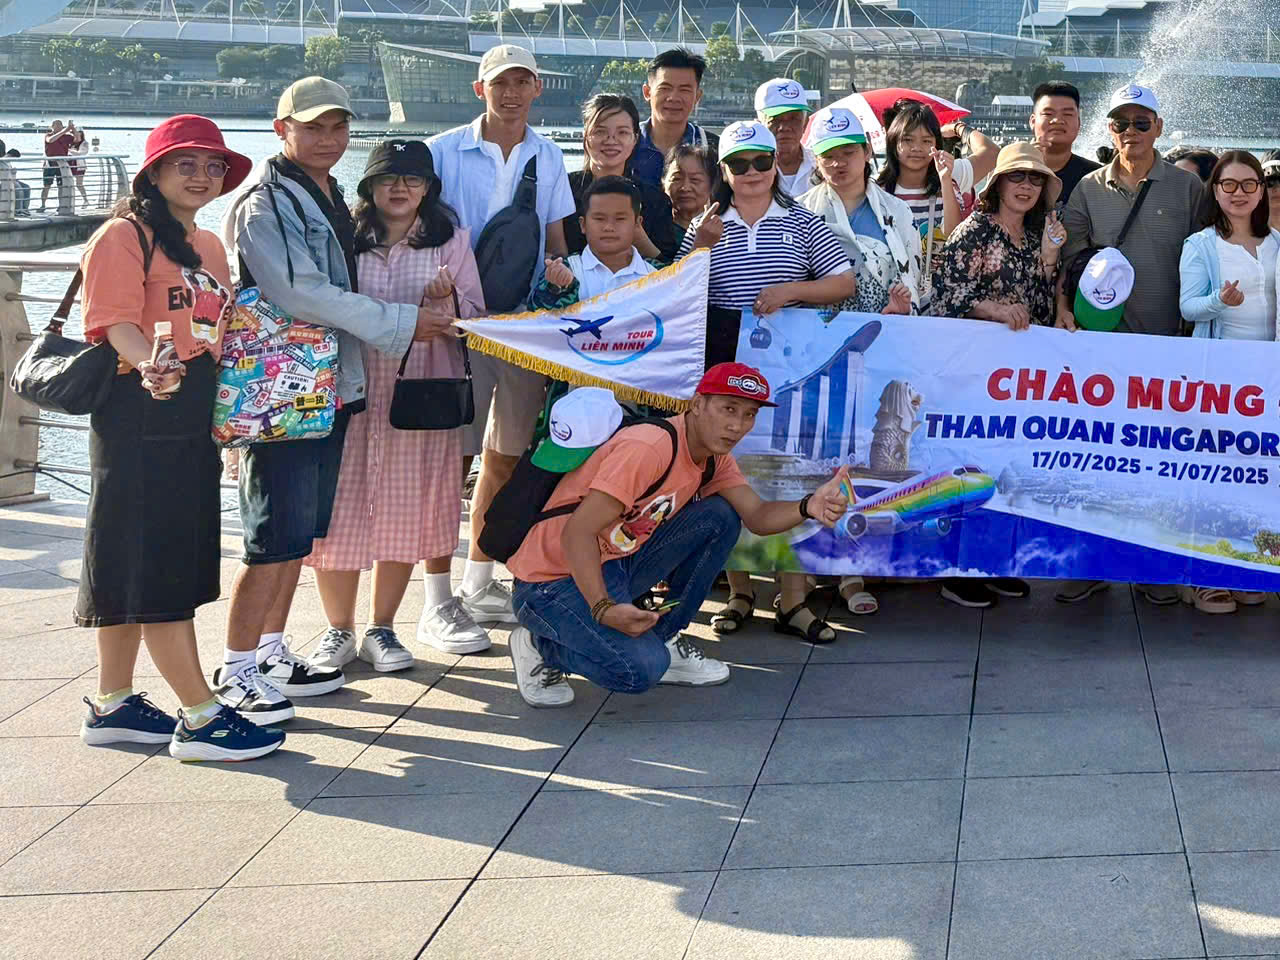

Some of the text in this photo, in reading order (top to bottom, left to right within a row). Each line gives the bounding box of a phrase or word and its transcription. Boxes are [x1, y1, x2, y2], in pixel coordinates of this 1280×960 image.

[581, 341, 645, 351] LIÊN MINH
[627, 330, 654, 339] TOUR
[987, 366, 1115, 407] CHÀO
[1127, 375, 1265, 417] MỪNG
[925, 413, 1017, 439] THAM
[1022, 416, 1114, 444] QUAN
[1032, 451, 1141, 474] 17/07/2025
[1158, 461, 1269, 485] 21/07/2025
